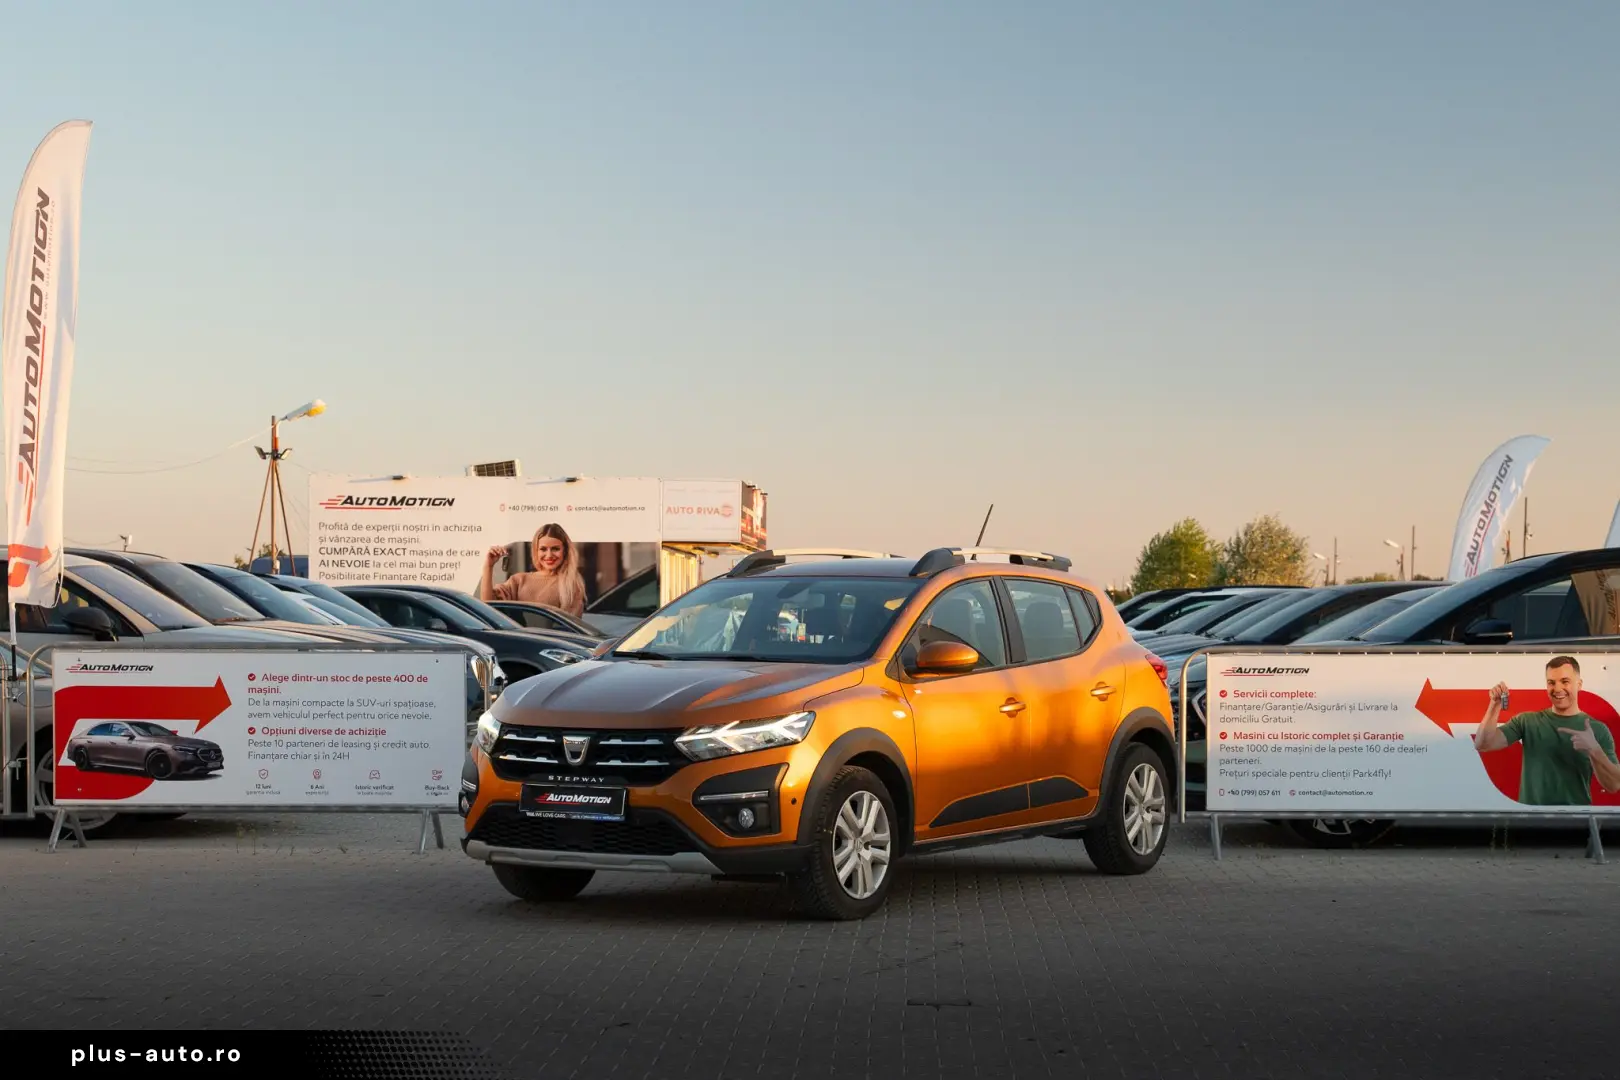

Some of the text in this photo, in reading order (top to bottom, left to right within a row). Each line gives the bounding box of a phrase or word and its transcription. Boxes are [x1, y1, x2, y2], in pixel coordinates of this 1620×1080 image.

[19, 186, 50, 475] AUTOMOTION
[341, 495, 455, 507] AUTOMOTION
[666, 506, 694, 515] AUTO
[1466, 454, 1514, 567] AUTOMOTION
[352, 522, 363, 532] de
[366, 523, 400, 534] experții
[403, 523, 429, 534] noștri
[443, 523, 482, 534] achiziția
[319, 536, 327, 545] și
[329, 535, 371, 544] vânzarea
[374, 536, 385, 544] de
[319, 546, 371, 556] CUMPĂRĂ
[374, 548, 407, 556] EXACT
[410, 549, 444, 558] mașina
[446, 549, 458, 557] de
[319, 560, 329, 568] AI
[332, 560, 370, 568] NEVOIE
[373, 560, 381, 568] la
[384, 560, 396, 568] cel
[400, 560, 417, 569] mai
[420, 560, 437, 568] bun
[319, 572, 371, 581] Posibilitate
[80, 664, 154, 672] AUTOMOTION
[262, 674, 428, 685] Alege dintr-un stoc de peste 400 de
[248, 686, 282, 696] mașini.
[1234, 689, 1317, 700] Servicii complete:
[248, 698, 437, 710] De la mașini compacte la SUV-uri spațioase,
[1349, 703, 1356, 714] și
[1358, 703, 1388, 711] Livrare
[1391, 703, 1398, 711] la
[273, 710, 310, 719] vehiculul
[312, 710, 344, 720] perfect
[346, 711, 376, 720] pentru
[378, 711, 400, 720] orice
[1220, 714, 1260, 723] domiciliu
[262, 727, 387, 738] Opțiuni diverse de achiziție
[1281, 732, 1310, 740] Istoric
[1312, 732, 1351, 742] complet
[1353, 732, 1361, 742] și
[1363, 732, 1404, 742] Garanție
[248, 740, 272, 748] Peste
[275, 740, 284, 748] 10
[286, 740, 326, 750] parteneri
[328, 740, 339, 748] de
[342, 740, 371, 750] leasing
[374, 740, 380, 750] și
[382, 740, 407, 749] credit
[1220, 744, 1428, 755] Peste 1000 de mașini de la peste 160 de dealeri
[248, 752, 289, 762] Finanțare
[291, 752, 312, 760] chiar
[314, 752, 321, 762] și
[332, 752, 350, 760] 24H
[1219, 757, 1262, 767] parteneri.
[548, 775, 605, 783] STEPWAY
[1220, 769, 1250, 780] Prețuri
[1252, 769, 1287, 779] speciale
[1289, 770, 1320, 779] pentru
[1353, 769, 1392, 779] Park4fly!
[546, 793, 612, 804] AUTOMOTION
